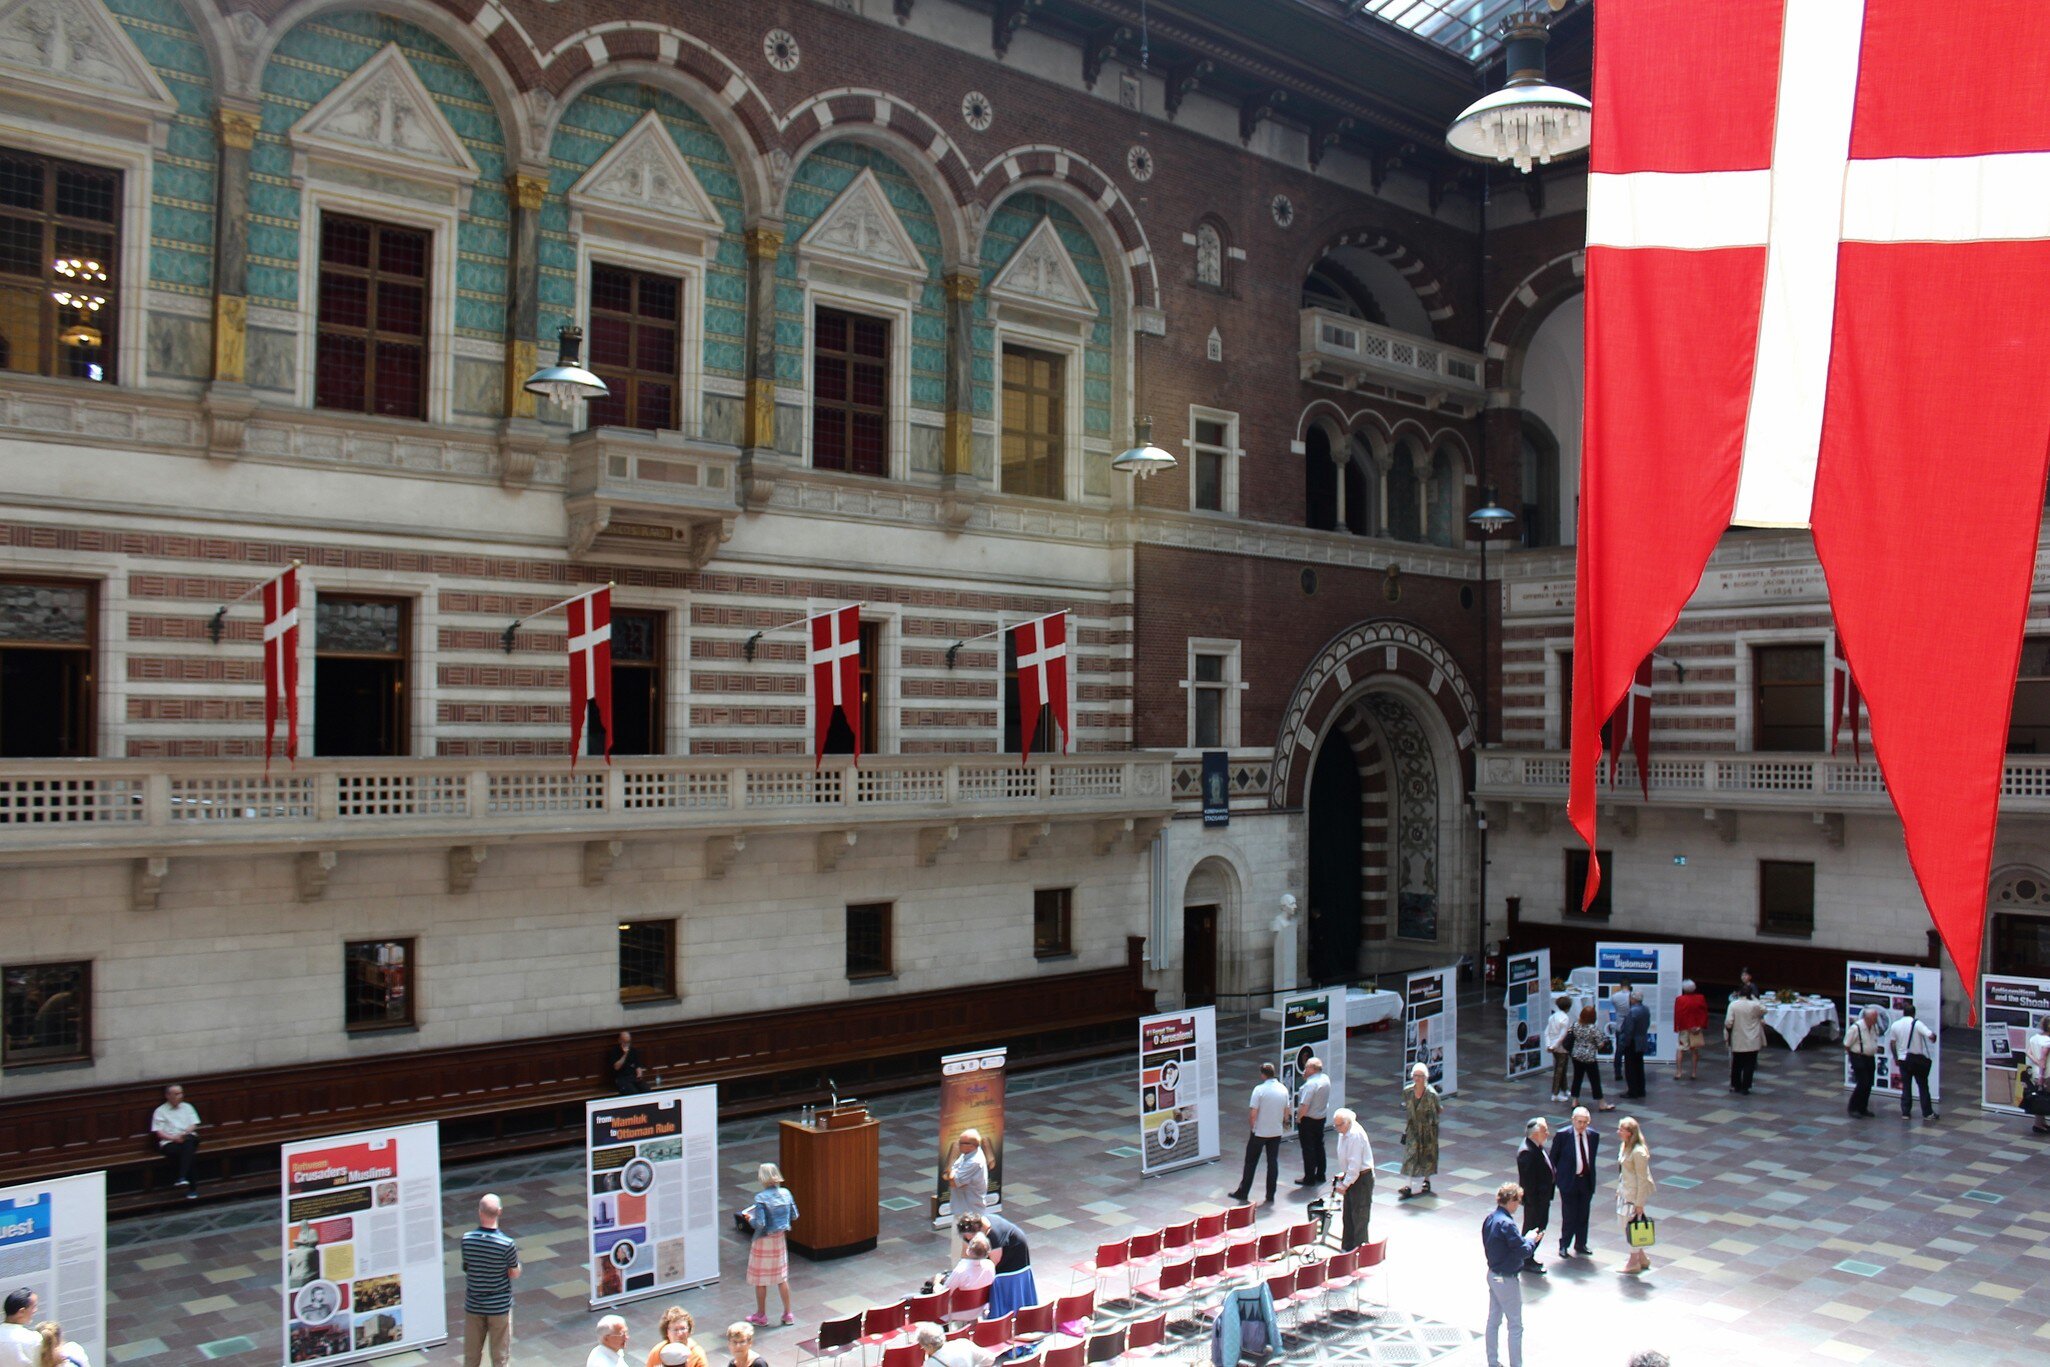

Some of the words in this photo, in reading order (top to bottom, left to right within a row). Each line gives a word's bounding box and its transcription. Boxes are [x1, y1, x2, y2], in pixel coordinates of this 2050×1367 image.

[1614, 959, 1653, 970] Diplomacy
[1854, 973, 1868, 982] The
[1868, 975, 1892, 985] British
[1874, 982, 1906, 993] Mandate
[2008, 994, 2019, 1003] the
[2020, 997, 2050, 1008] Shoah
[1306, 1013, 1325, 1023] Palestine
[1160, 1029, 1193, 1044] Jerusalem!
[596, 1116, 611, 1124] from
[611, 1114, 648, 1128] Mamluk
[610, 1129, 617, 1137] to
[616, 1127, 654, 1140] Ottoman
[655, 1123, 676, 1134] Rule
[293, 1160, 328, 1172] Between
[294, 1166, 348, 1184] Crusaders
[333, 1176, 348, 1185] and
[348, 1167, 392, 1182] Muslims
